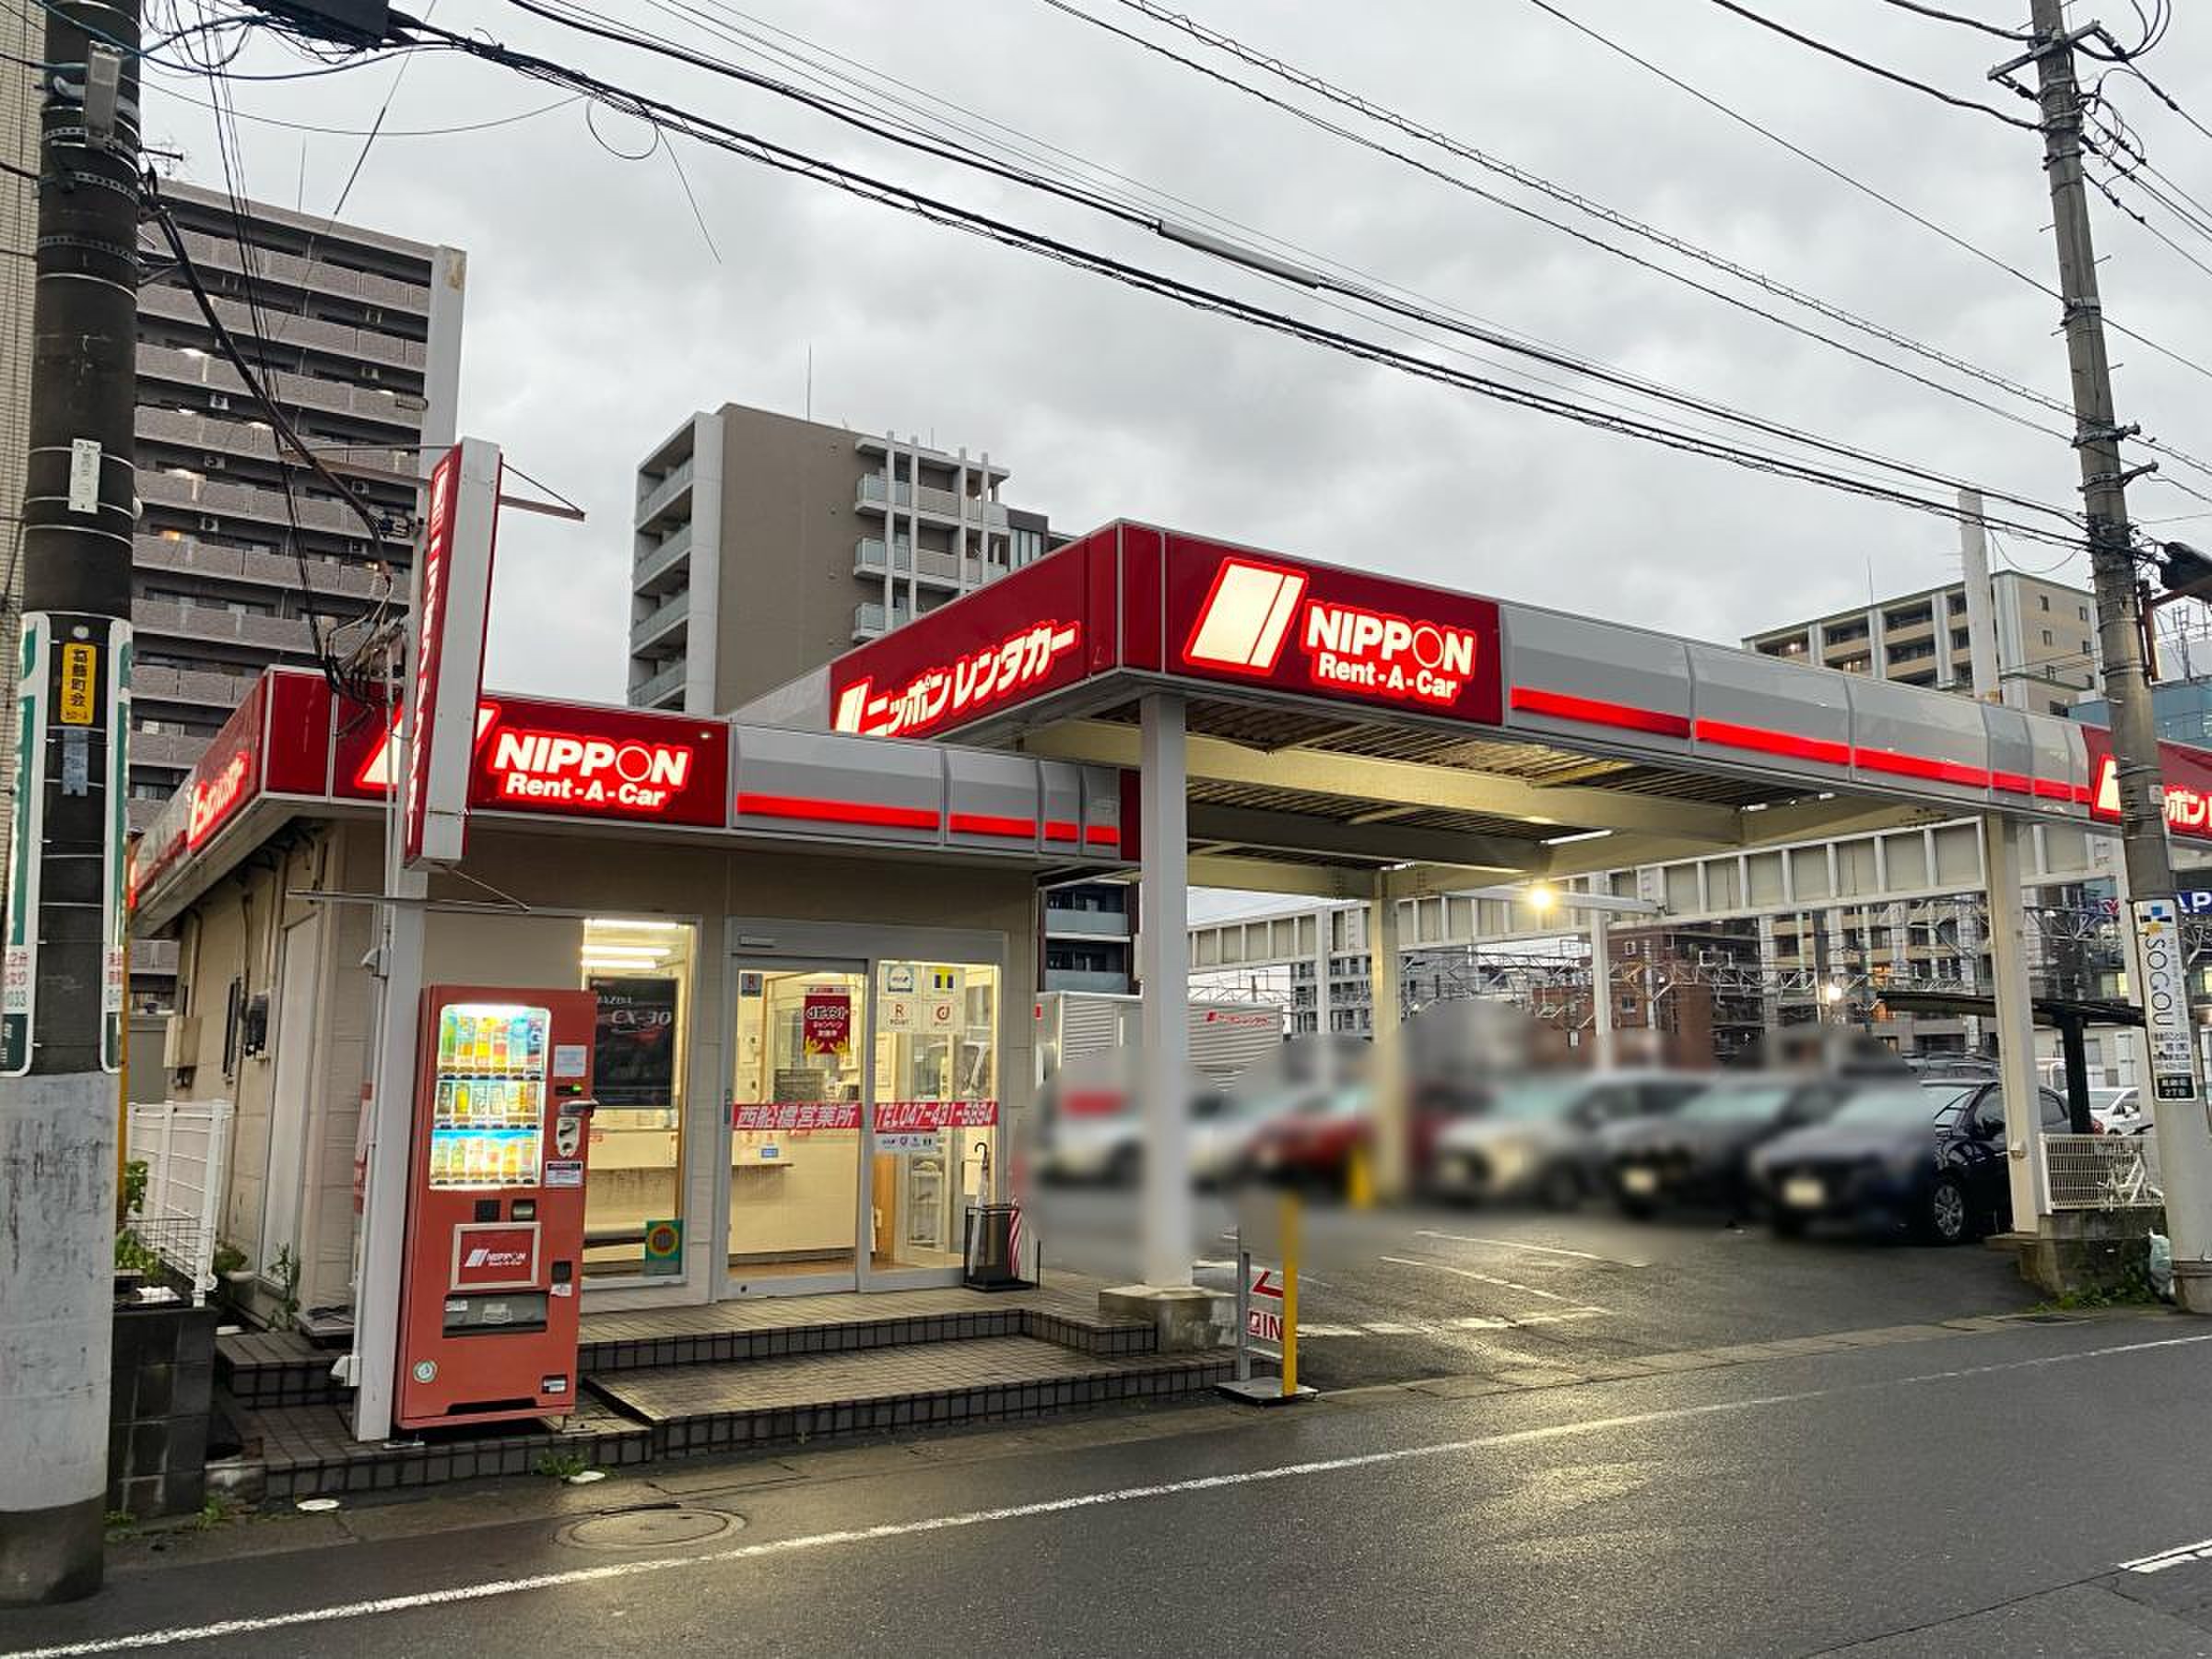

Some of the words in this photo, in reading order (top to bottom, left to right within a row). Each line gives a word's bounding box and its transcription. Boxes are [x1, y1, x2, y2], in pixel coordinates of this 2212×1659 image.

[1307, 606, 1474, 675] NIPPON
[863, 627, 1076, 736] ニッポンレンタカー
[1319, 652, 1457, 698] Rent-A-Car
[494, 734, 688, 785] NIPPON
[506, 772, 666, 806] Rent-A-Car
[611, 1009, 672, 1026] CX-30
